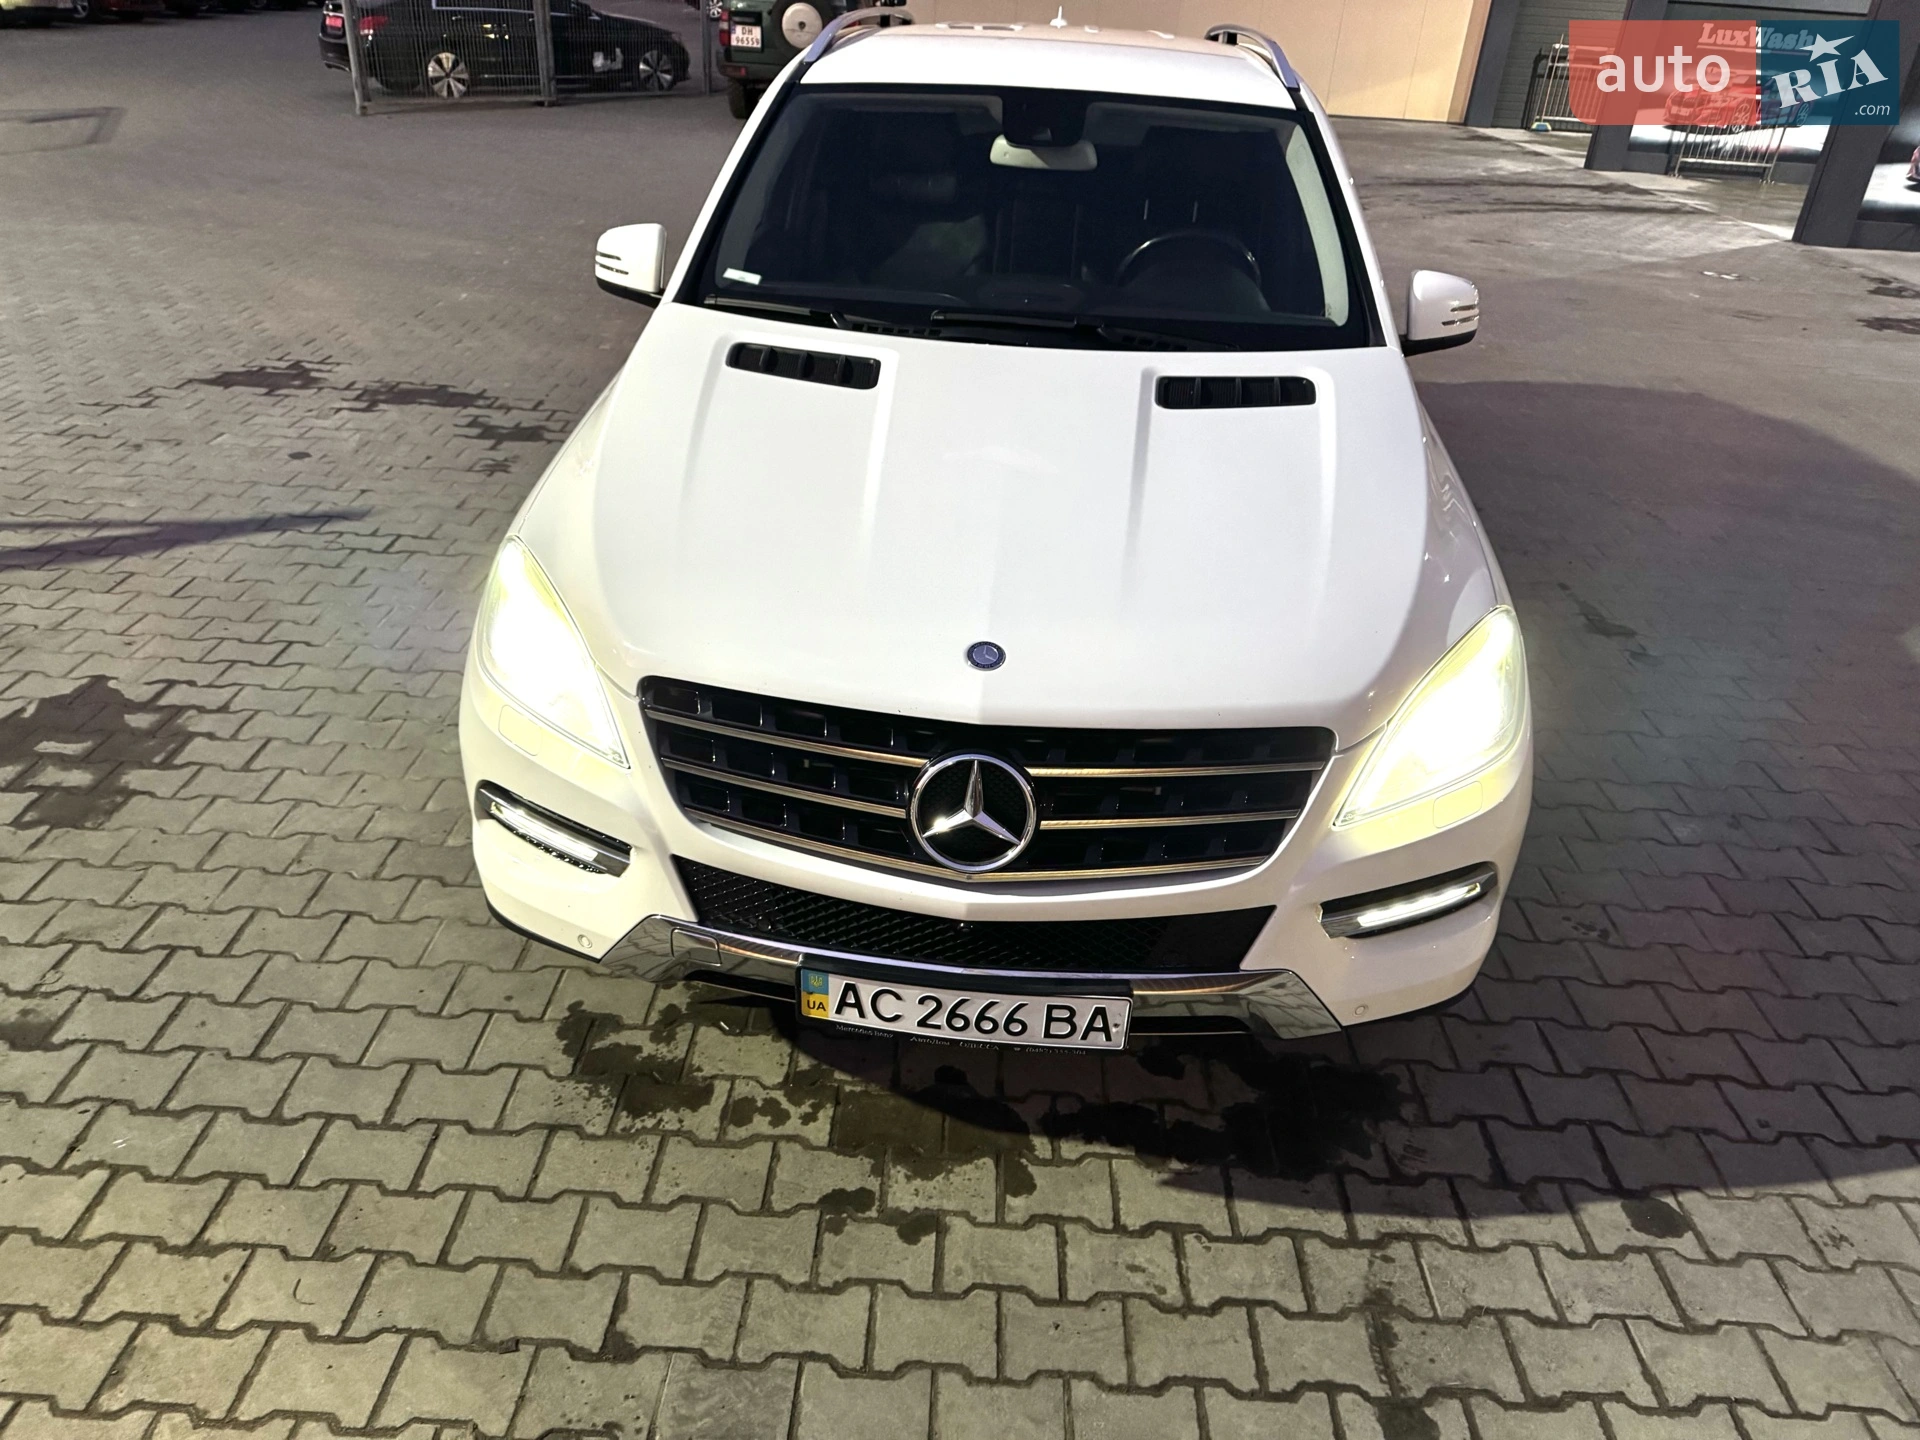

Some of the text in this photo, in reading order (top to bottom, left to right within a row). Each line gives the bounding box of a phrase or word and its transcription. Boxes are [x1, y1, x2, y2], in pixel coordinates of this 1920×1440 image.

[1698, 22, 1814, 50] LuxWash
[806, 999, 827, 1012] UA
[834, 981, 1113, 1043] AC 2666 BA
